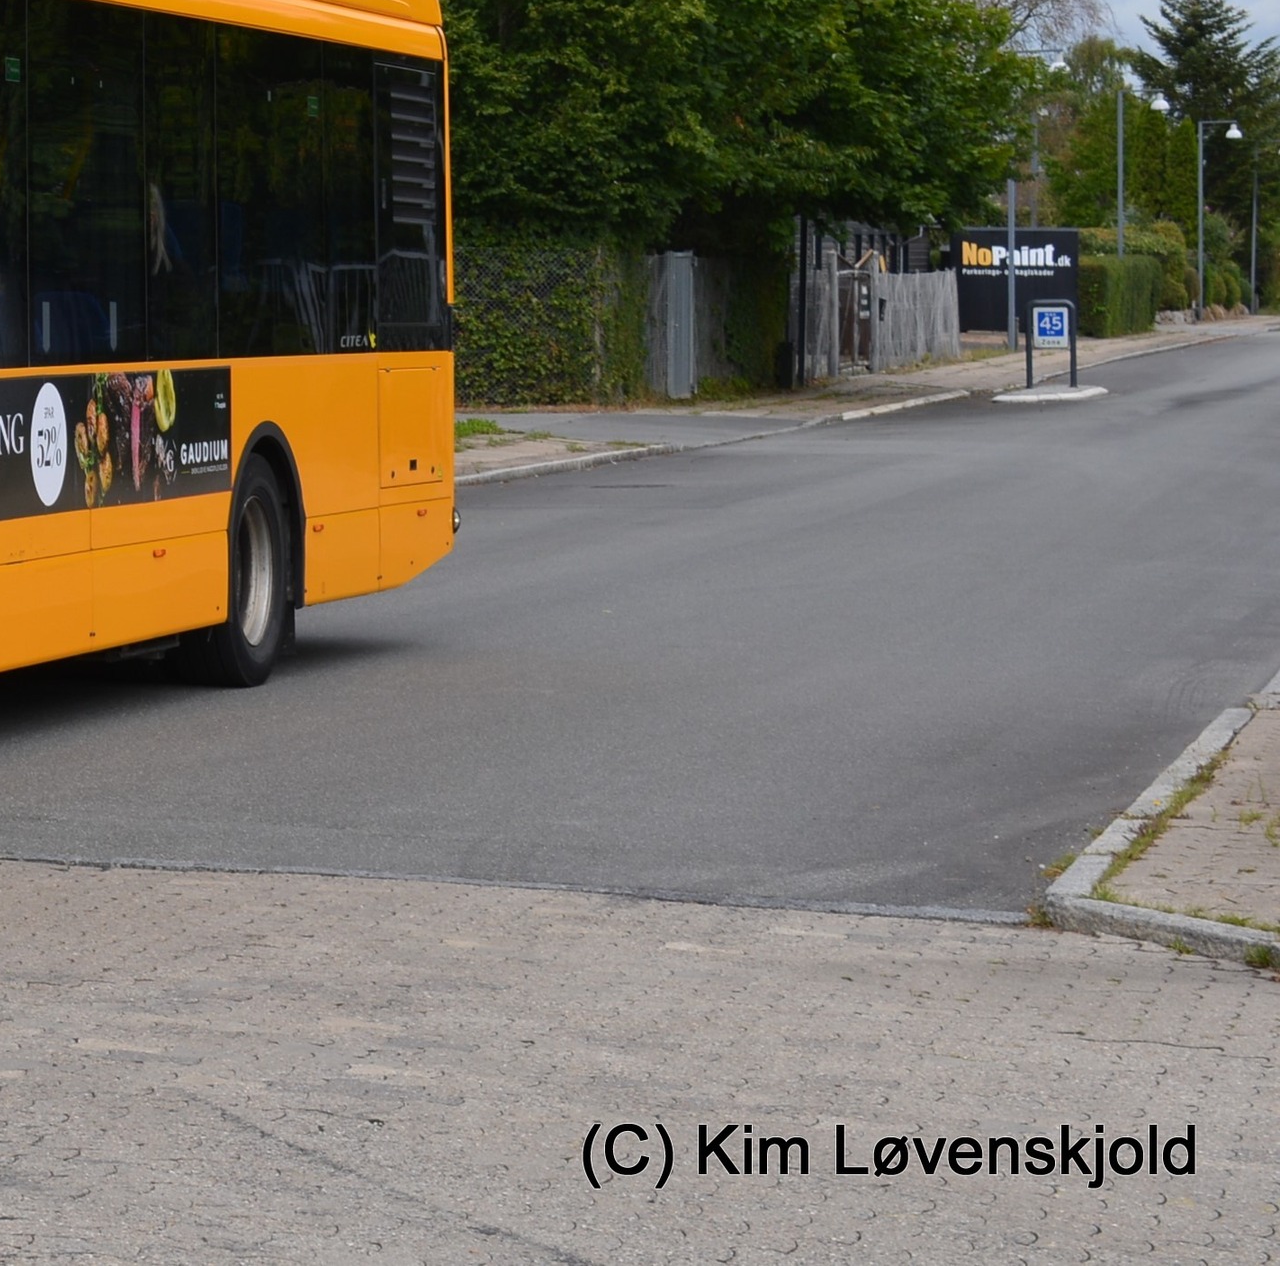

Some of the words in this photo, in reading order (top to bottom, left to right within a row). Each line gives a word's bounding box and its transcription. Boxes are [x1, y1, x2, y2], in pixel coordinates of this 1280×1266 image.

[1040, 317, 1062, 330] 45
[37, 424, 62, 468] 52%
[180, 439, 228, 465] GAUDIUM
